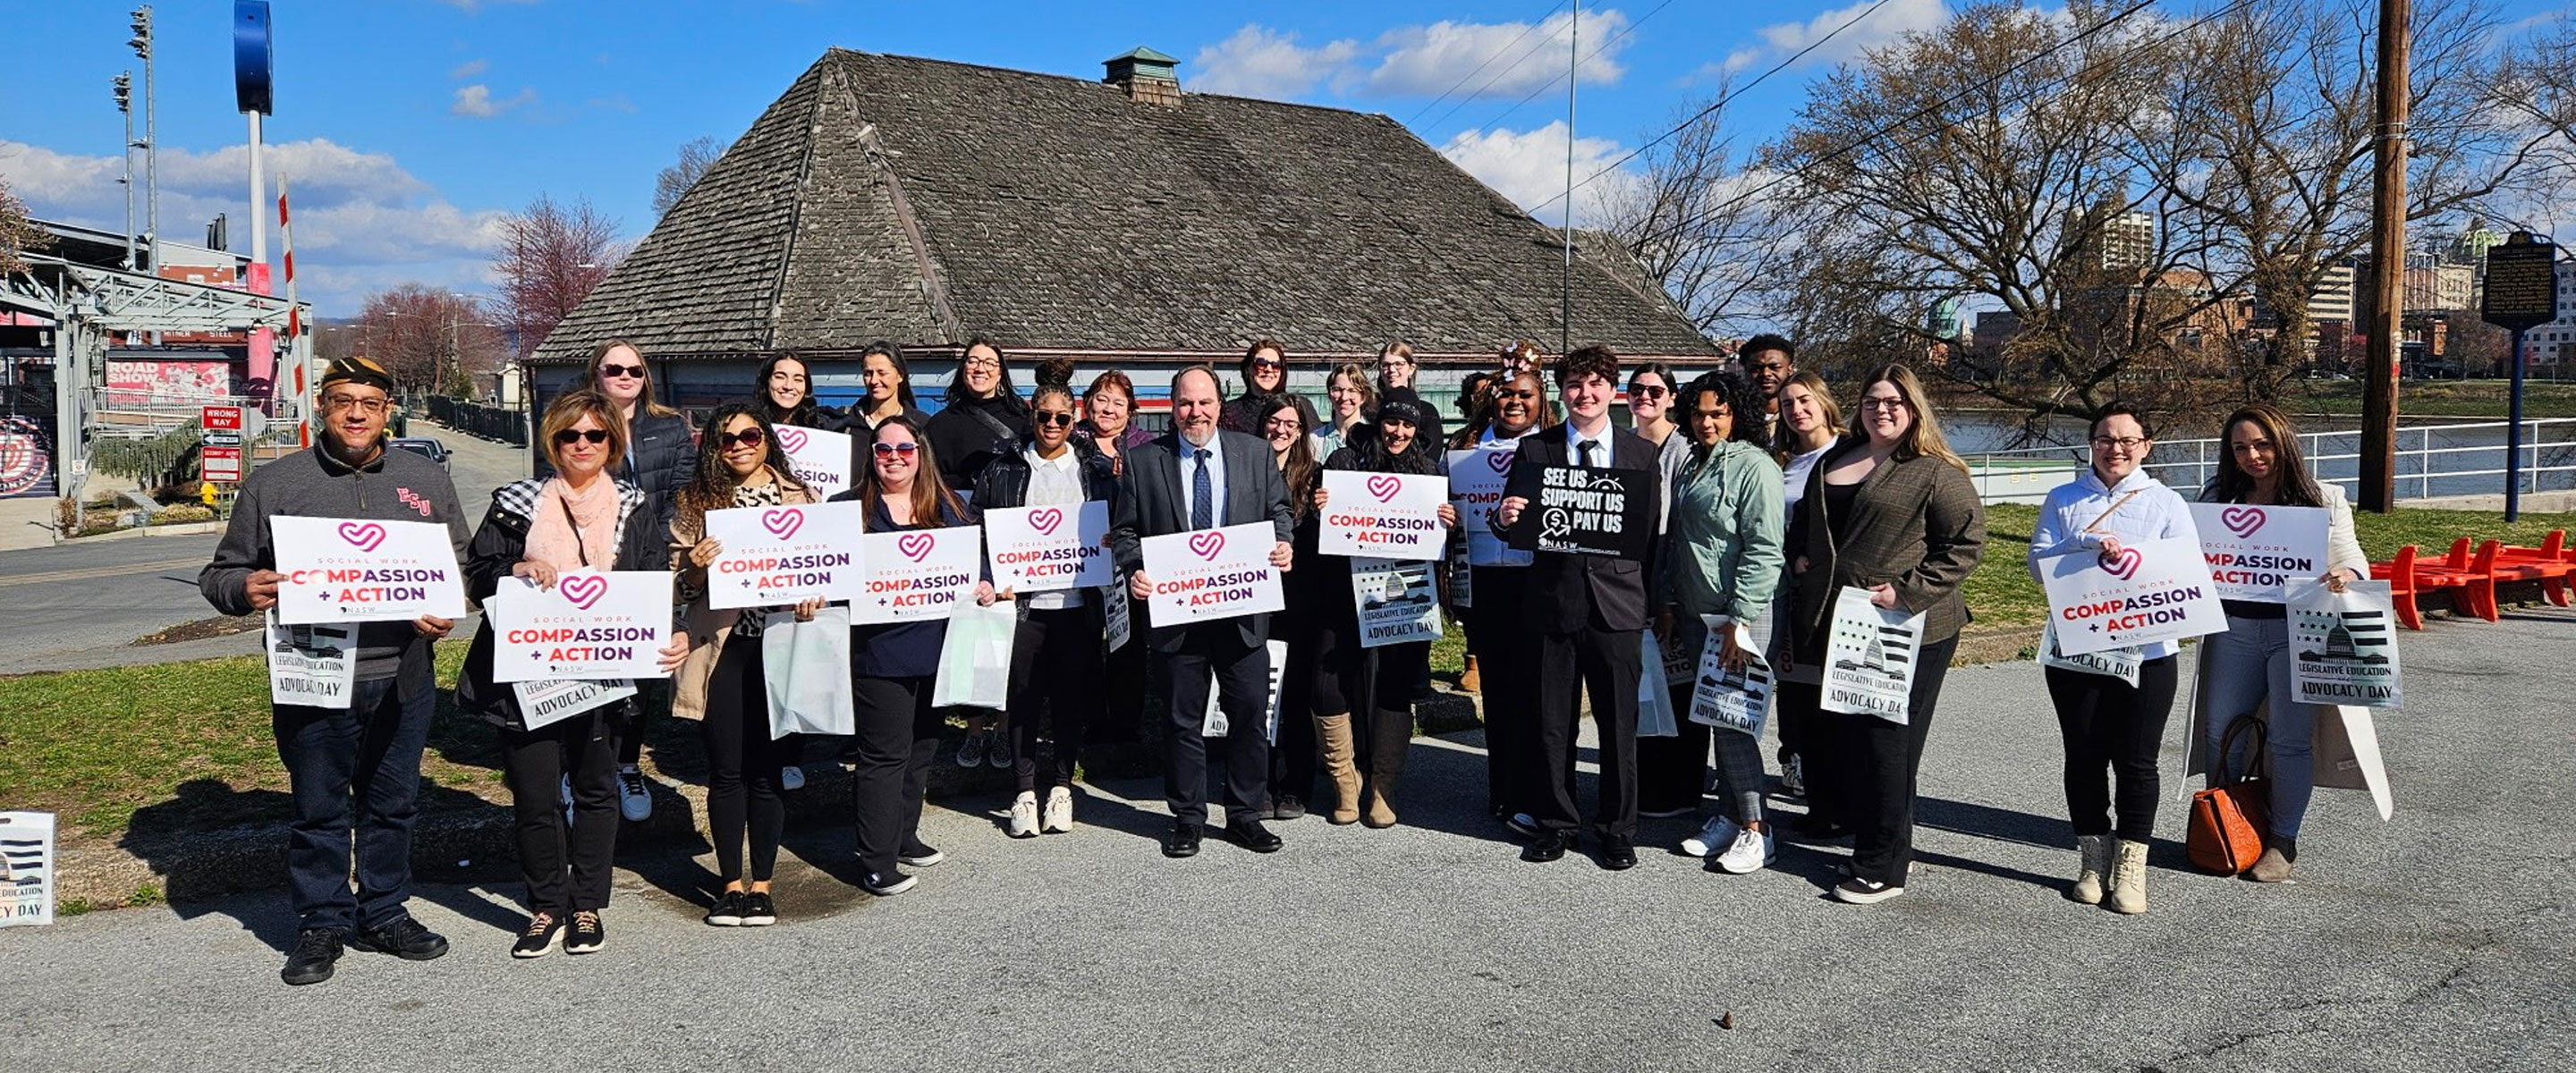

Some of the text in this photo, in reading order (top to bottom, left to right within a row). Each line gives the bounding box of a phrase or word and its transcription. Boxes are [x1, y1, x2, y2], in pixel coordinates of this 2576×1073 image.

[109, 361, 159, 373] ROAD
[108, 373, 157, 383] SHOW
[1543, 467, 1588, 488] SEE US
[397, 488, 431, 515] ESU
[1541, 487, 1624, 512] SUPPORT US
[1329, 515, 1435, 530] COMPASSION
[1573, 511, 1623, 533] PAY US
[1358, 531, 1418, 545] ACTION
[1547, 540, 1578, 549] NASW
[2206, 542, 2243, 550] OCIAL
[741, 546, 786, 554] SOCIAL
[996, 545, 1099, 564] COMPASSION
[720, 553, 850, 573] COMPASSION
[1025, 562, 1085, 577] ACTION
[2204, 553, 2311, 571] MPASSION
[291, 569, 445, 585] COMPASSION
[1174, 567, 1211, 576] SOCIAL
[2212, 570, 2289, 587] ACTION
[758, 571, 831, 589] ACTION
[1157, 569, 1267, 595] COMPASSION
[338, 587, 426, 602] ACTION
[1190, 587, 1253, 606] ACTION
[2082, 579, 2174, 599] SOCIAL WORK
[893, 590, 954, 607] ACTION
[2063, 586, 2202, 621] COMPASSION
[2106, 607, 2186, 632] ACTION
[508, 628, 655, 644] COMPASSION
[1368, 623, 1414, 639] ADVOCACY
[548, 646, 632, 662] ACTION
[2299, 663, 2392, 676] LEGISLATIVE EDUCATION
[1832, 671, 1873, 686] LEGISLATIVE
[2301, 681, 2392, 697] ADVOCACY DAY
[535, 682, 597, 717] ADVOCACY
[1830, 689, 1885, 711] ADVOCACY
[1694, 703, 1758, 732] ADVOCACY DAY
[0, 887, 43, 897] DUCATION
[18, 904, 42, 917] DAY
